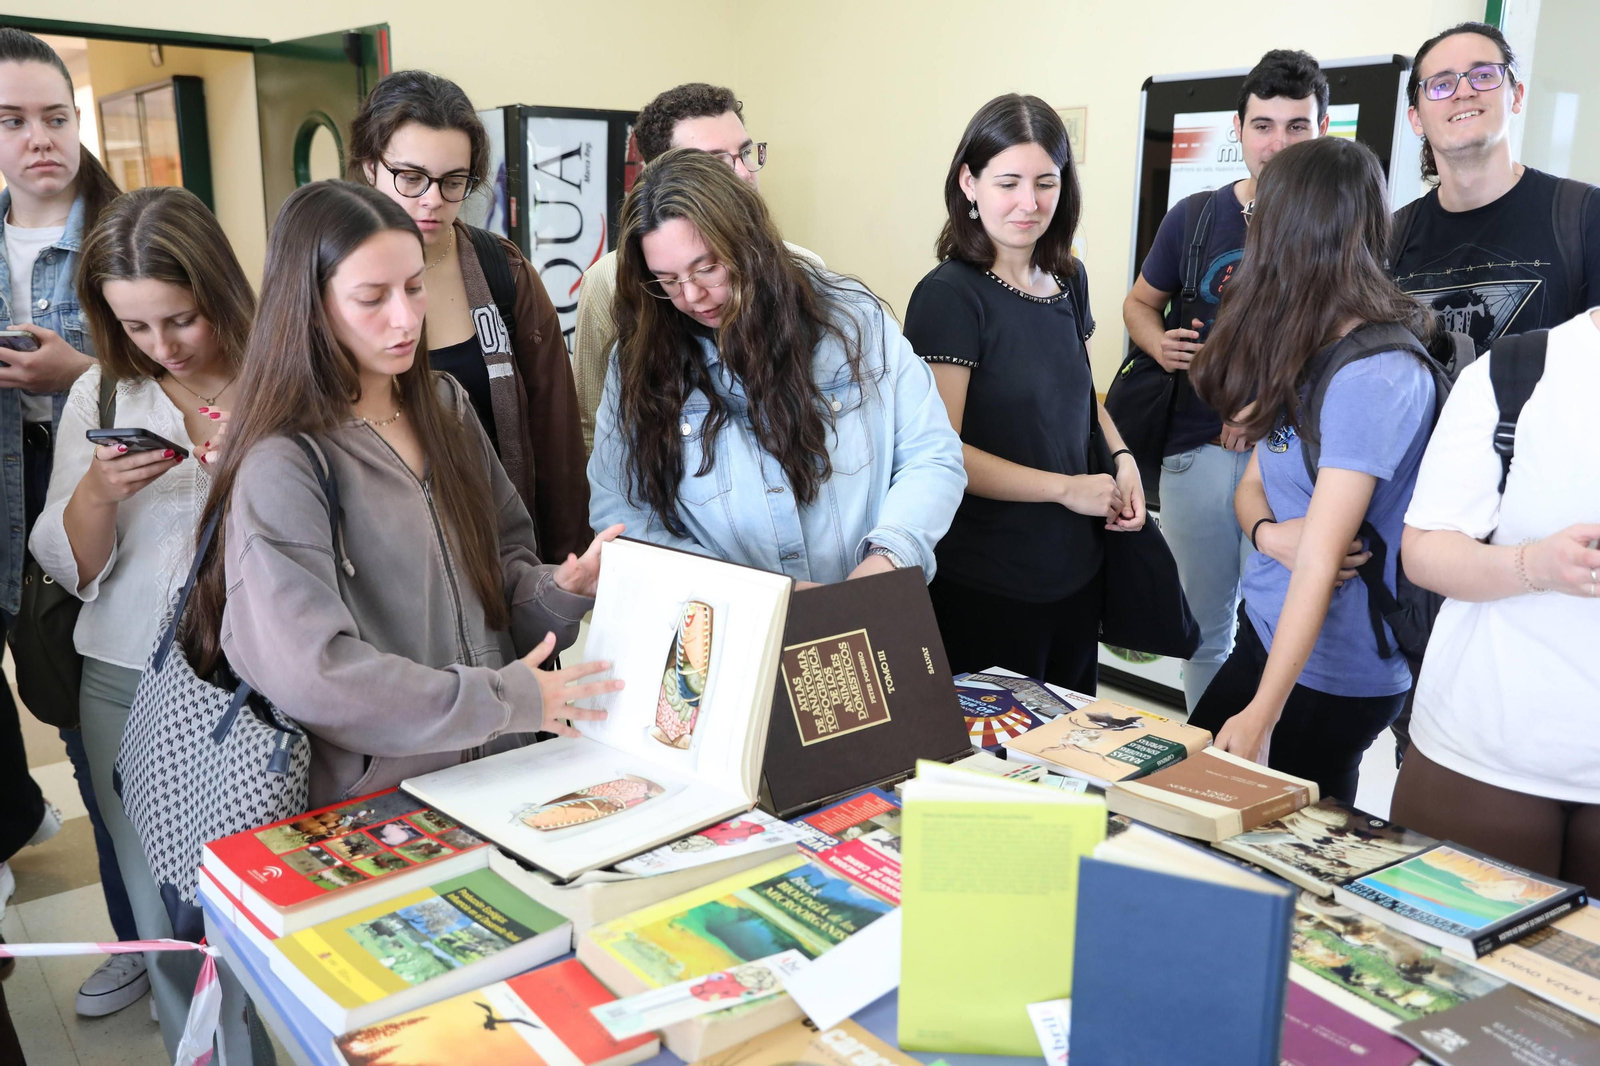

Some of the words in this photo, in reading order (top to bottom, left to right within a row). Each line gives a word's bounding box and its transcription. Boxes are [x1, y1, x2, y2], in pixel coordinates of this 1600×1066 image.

[1446, 260, 1540, 275] WAVES
[857, 651, 871, 682] POPESKO
[922, 647, 934, 675] SALVAT
[798, 650, 822, 718] ANATOMIA
[824, 667, 836, 689] LOS
[830, 653, 854, 713] ANIMALES
[839, 642, 868, 721] DOMESTICOS
[880, 662, 895, 694] TOMO
[793, 677, 809, 712] ATLAS
[808, 646, 838, 732] TOPOGRAFICA
[831, 690, 842, 706] DE
[866, 682, 877, 704] PETER
[814, 719, 827, 735] DE
[1136, 739, 1168, 751] CAPRINAS
[1110, 751, 1145, 764] RAZAS
[776, 881, 830, 916] BIOLOGÍA
[1342, 884, 1375, 901] OVINO
[1350, 882, 1394, 903] GALICIA
[1378, 898, 1393, 910] DE
[1395, 901, 1411, 910] EN
[1393, 906, 1467, 936] PRODUCCION
[1412, 908, 1453, 926] CARNE
[1500, 956, 1541, 977] OVINA
[1546, 977, 1583, 995] RAZA
